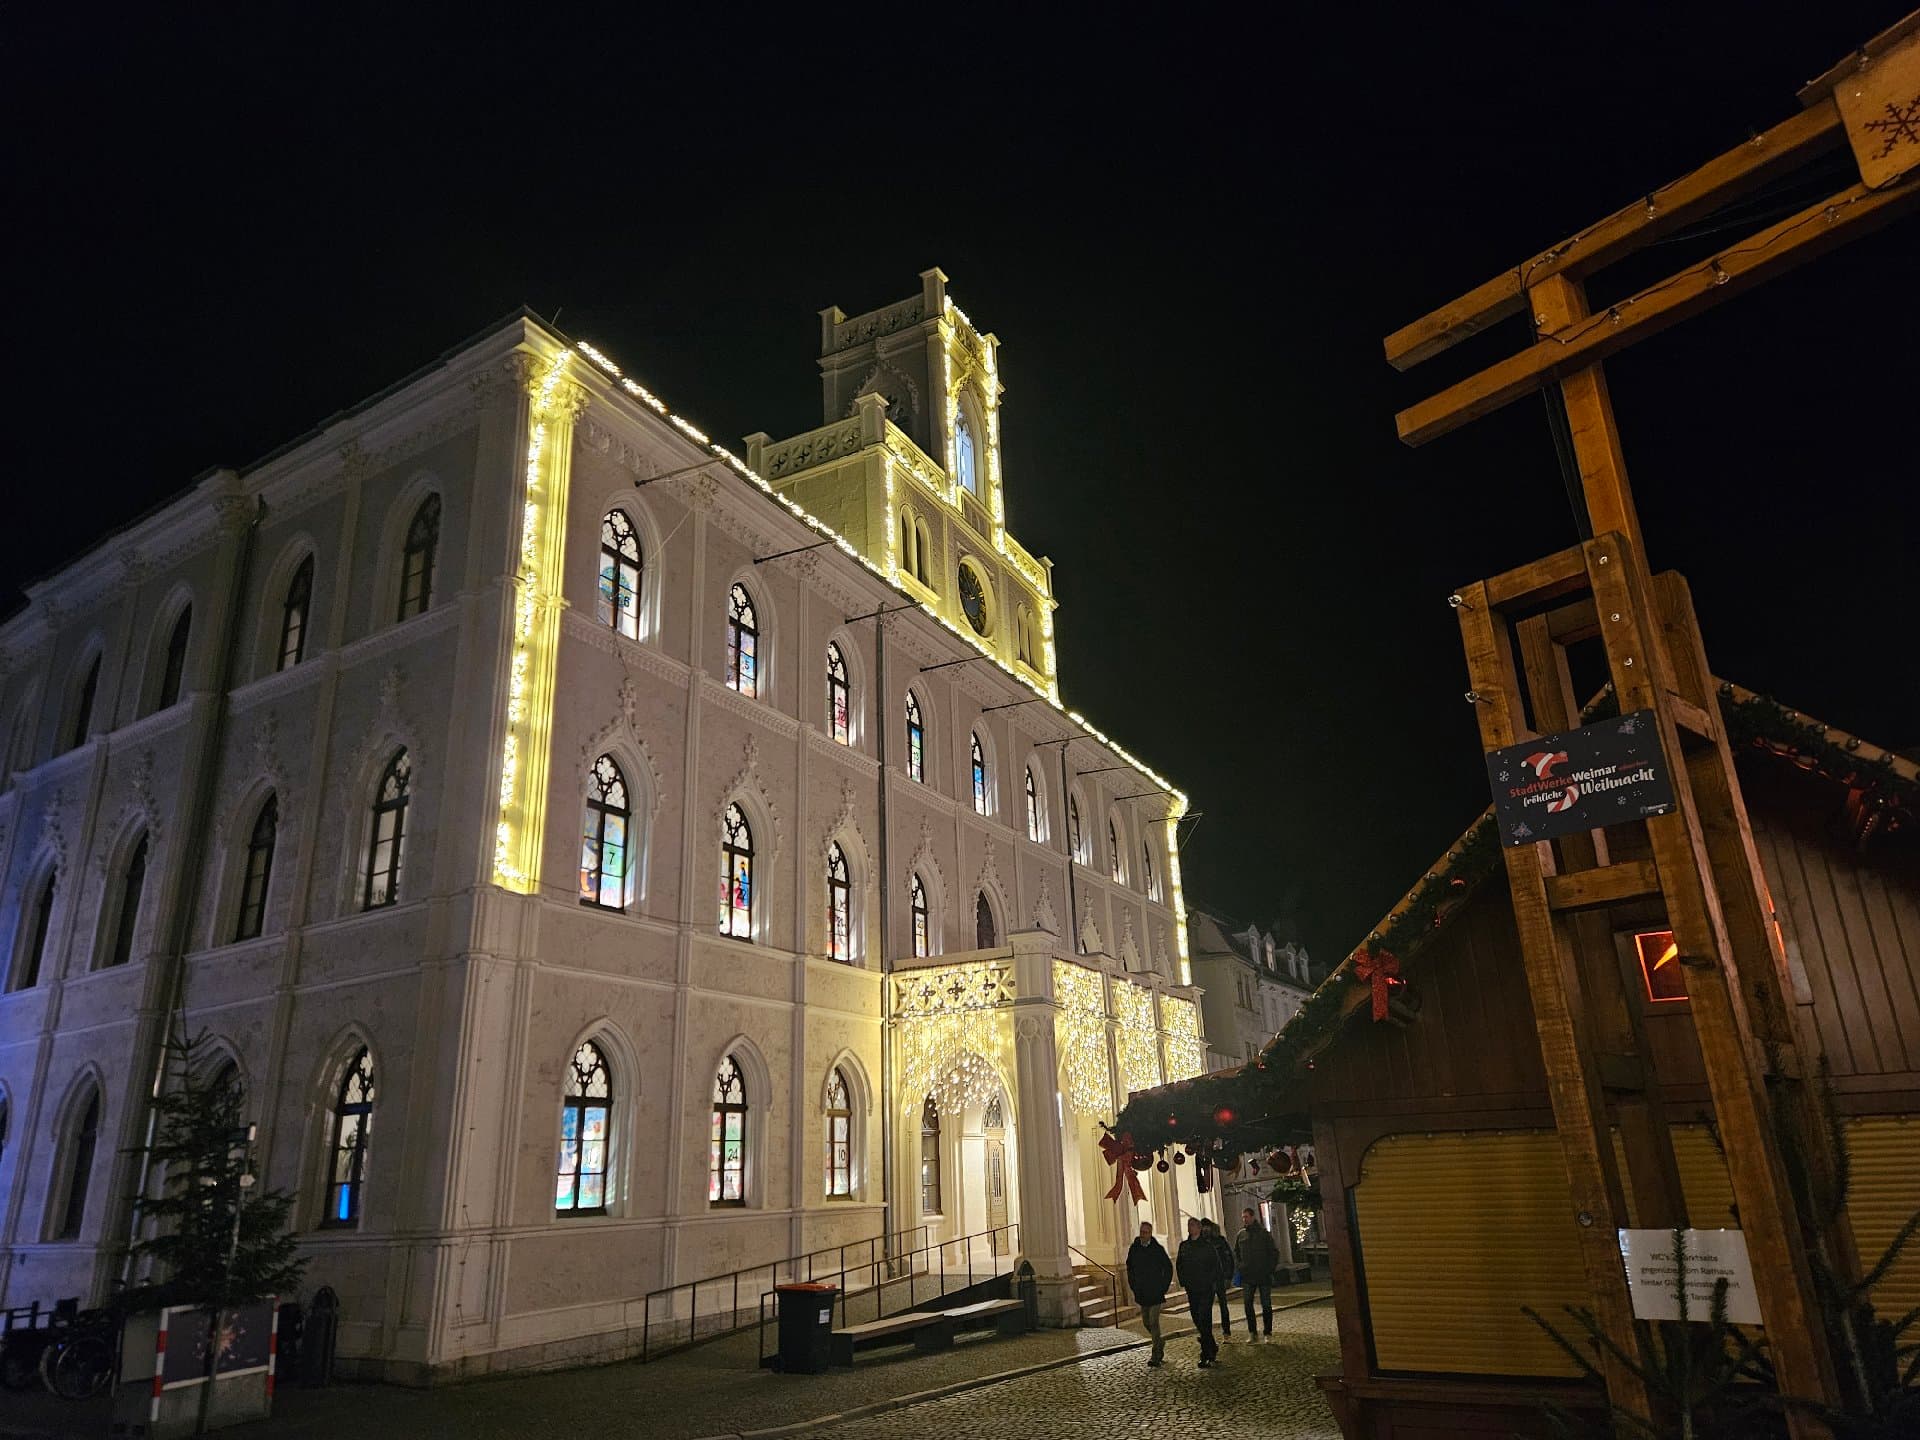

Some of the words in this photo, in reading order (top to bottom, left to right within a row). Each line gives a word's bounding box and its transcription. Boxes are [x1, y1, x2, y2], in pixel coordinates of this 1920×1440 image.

[1580, 768, 1656, 795] Weihnacht
[608, 851, 616, 865] 7
[728, 1147, 739, 1162] 24
[838, 1147, 847, 1161] 10
